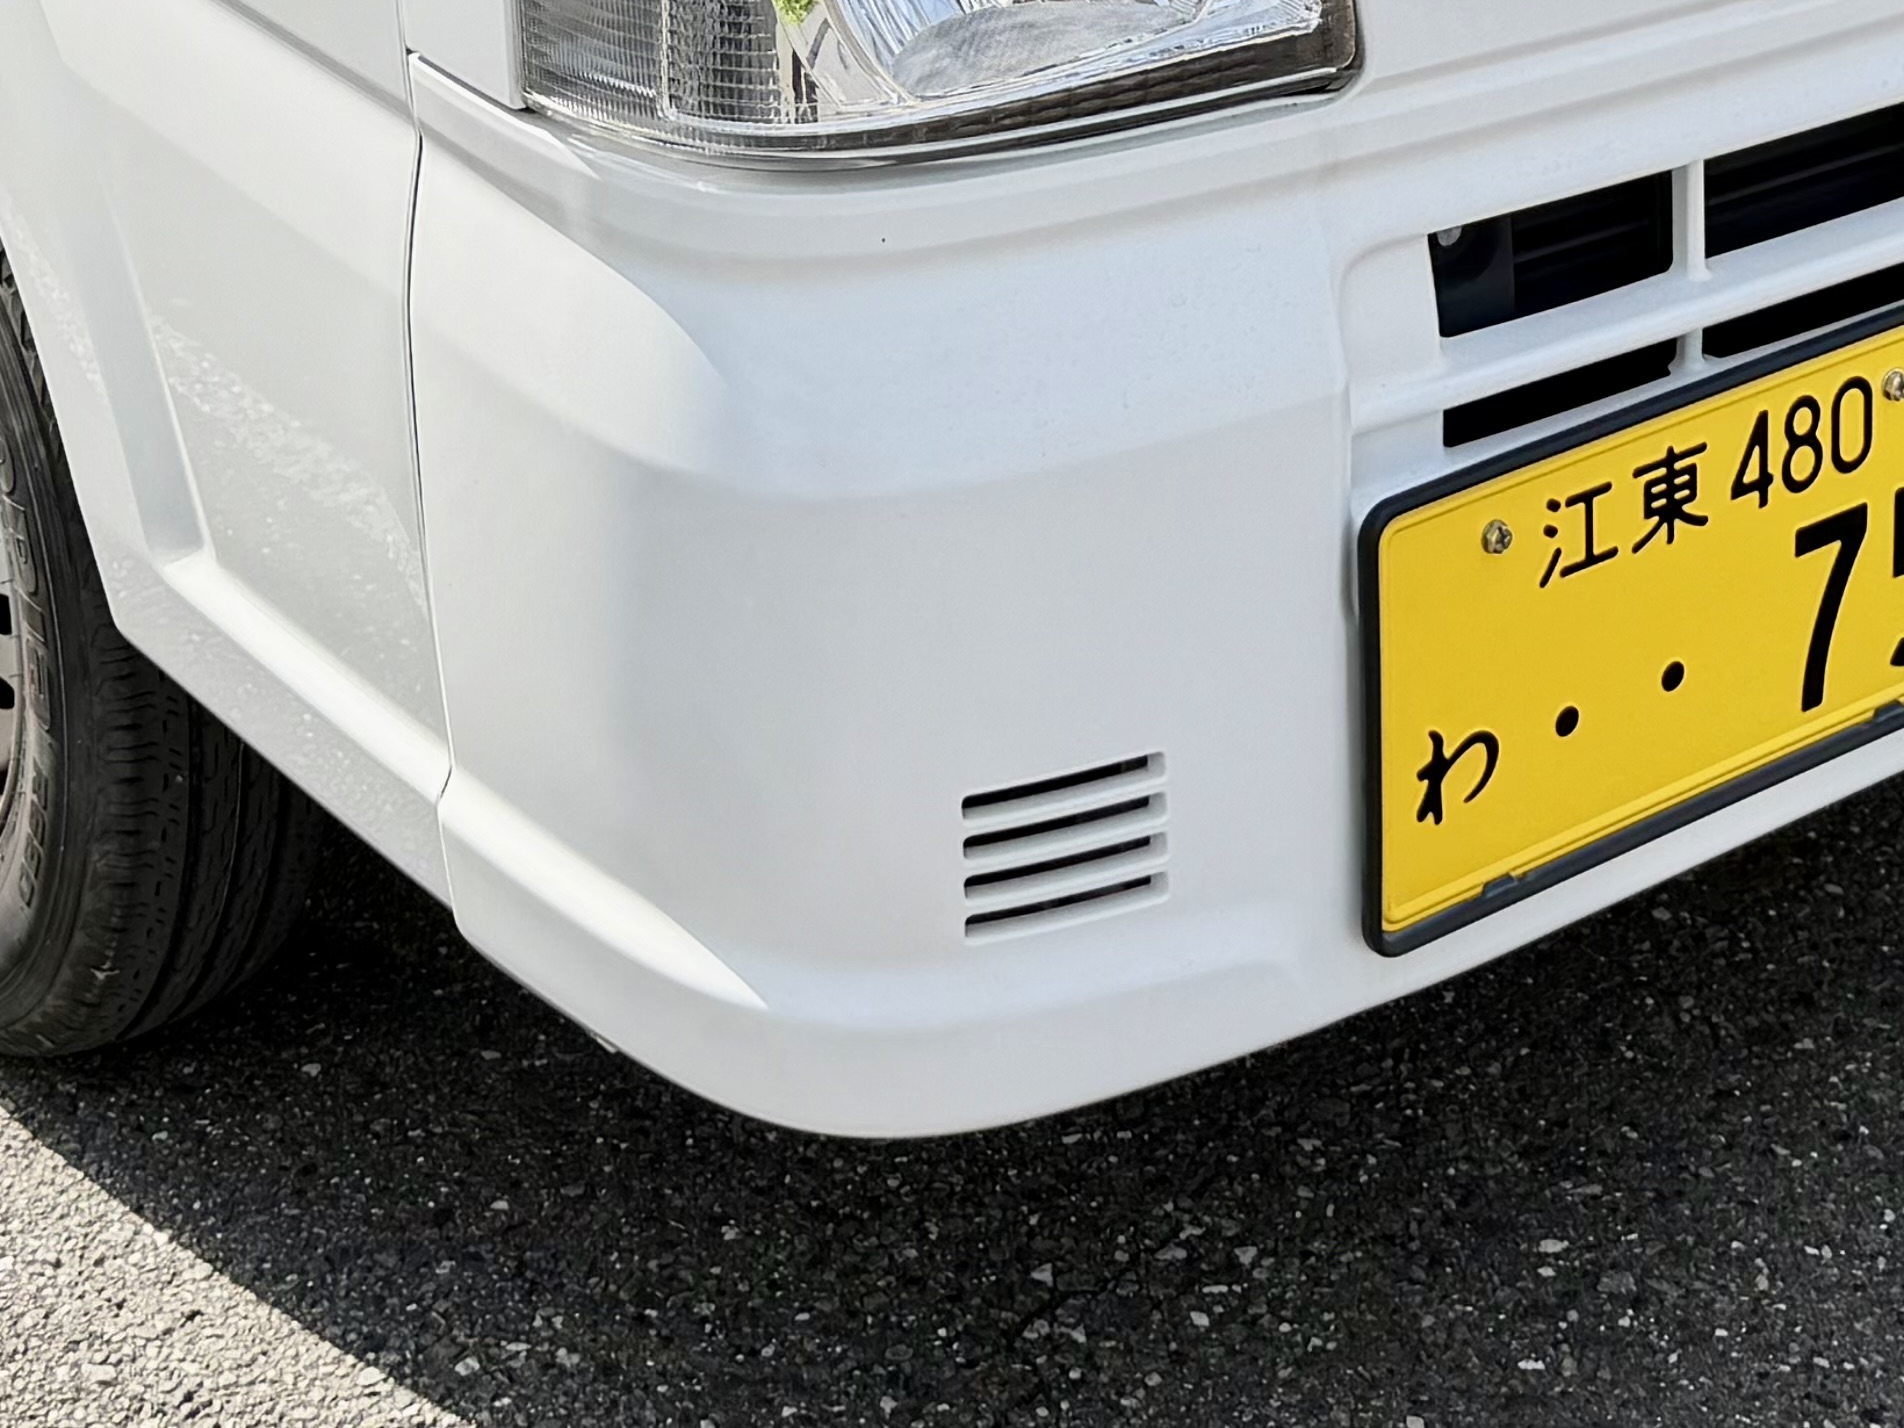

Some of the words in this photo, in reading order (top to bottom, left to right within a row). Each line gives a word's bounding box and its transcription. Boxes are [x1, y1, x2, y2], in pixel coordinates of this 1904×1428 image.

[1538, 442, 1710, 589] 江東
[1730, 375, 1873, 508] 480
[1416, 729, 1501, 826] わ
